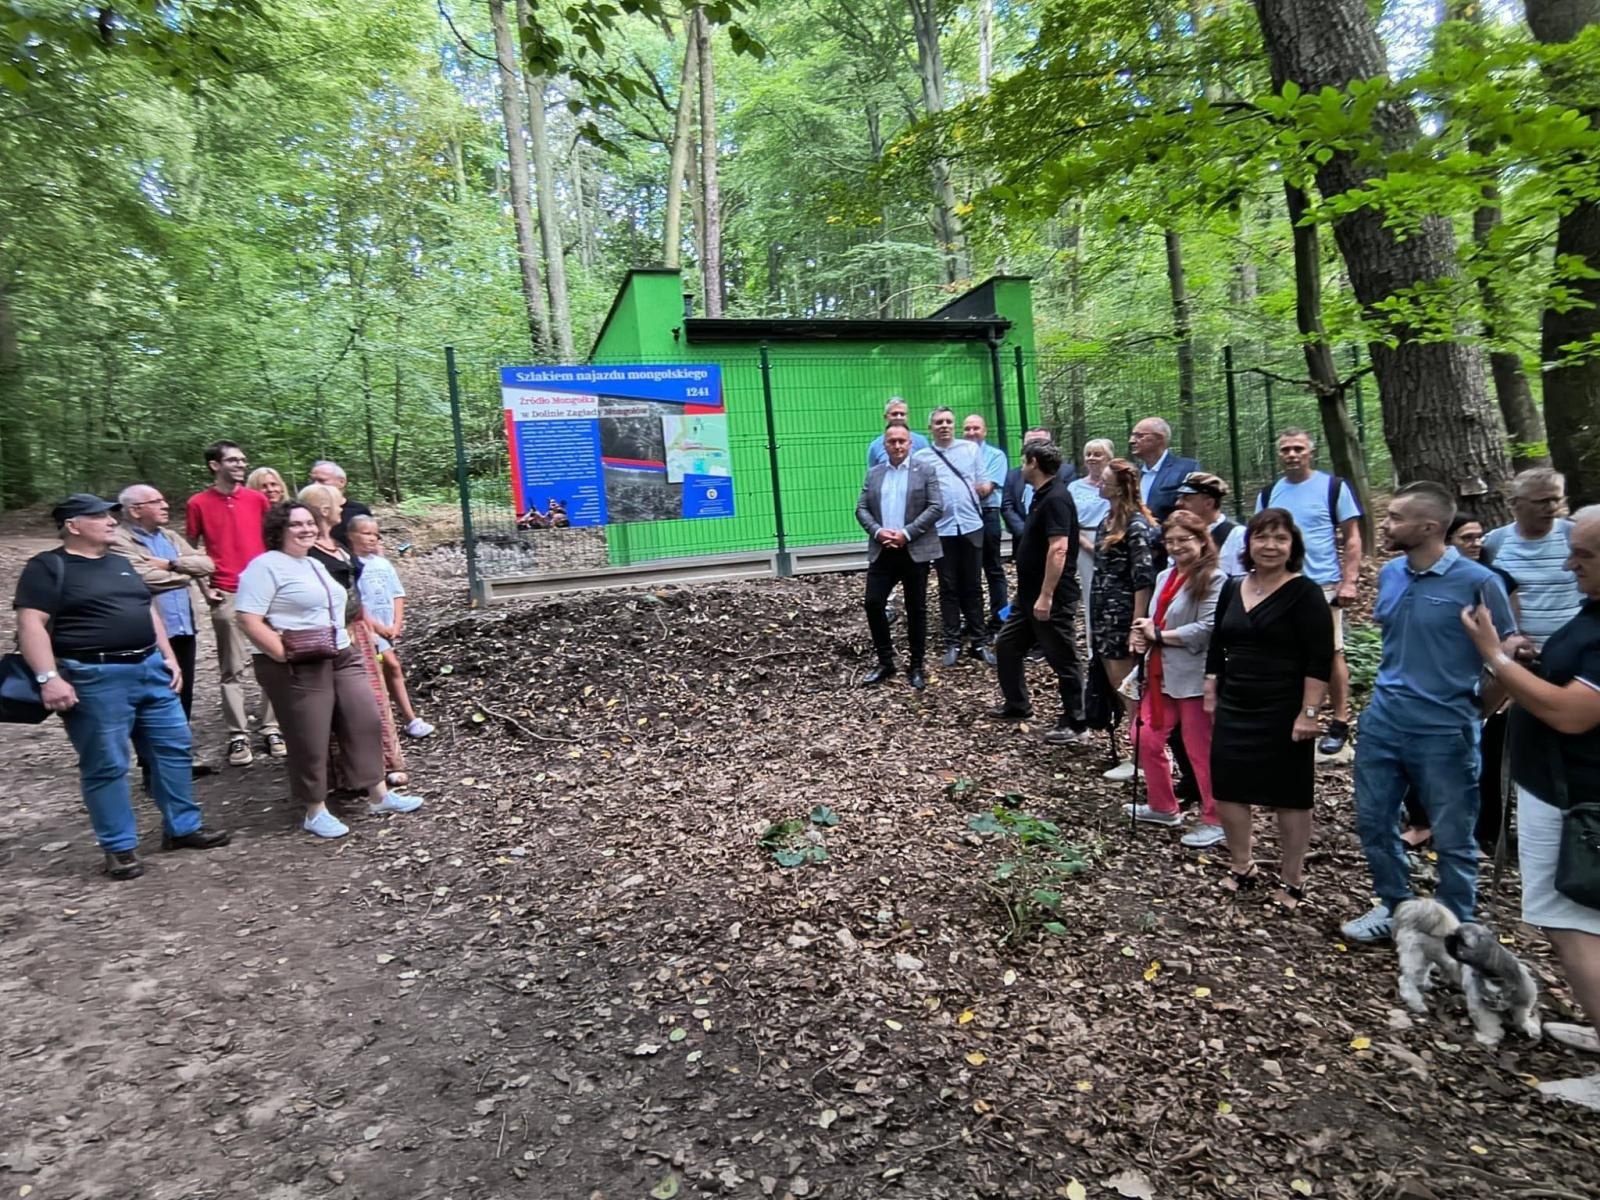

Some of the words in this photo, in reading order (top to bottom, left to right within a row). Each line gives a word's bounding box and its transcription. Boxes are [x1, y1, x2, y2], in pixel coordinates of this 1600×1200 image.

[516, 371, 573, 382] Szlakiem
[576, 370, 625, 383] najazdu
[628, 368, 708, 381] mongolskiego
[686, 387, 709, 397] 1241
[532, 408, 564, 418] Dolinie
